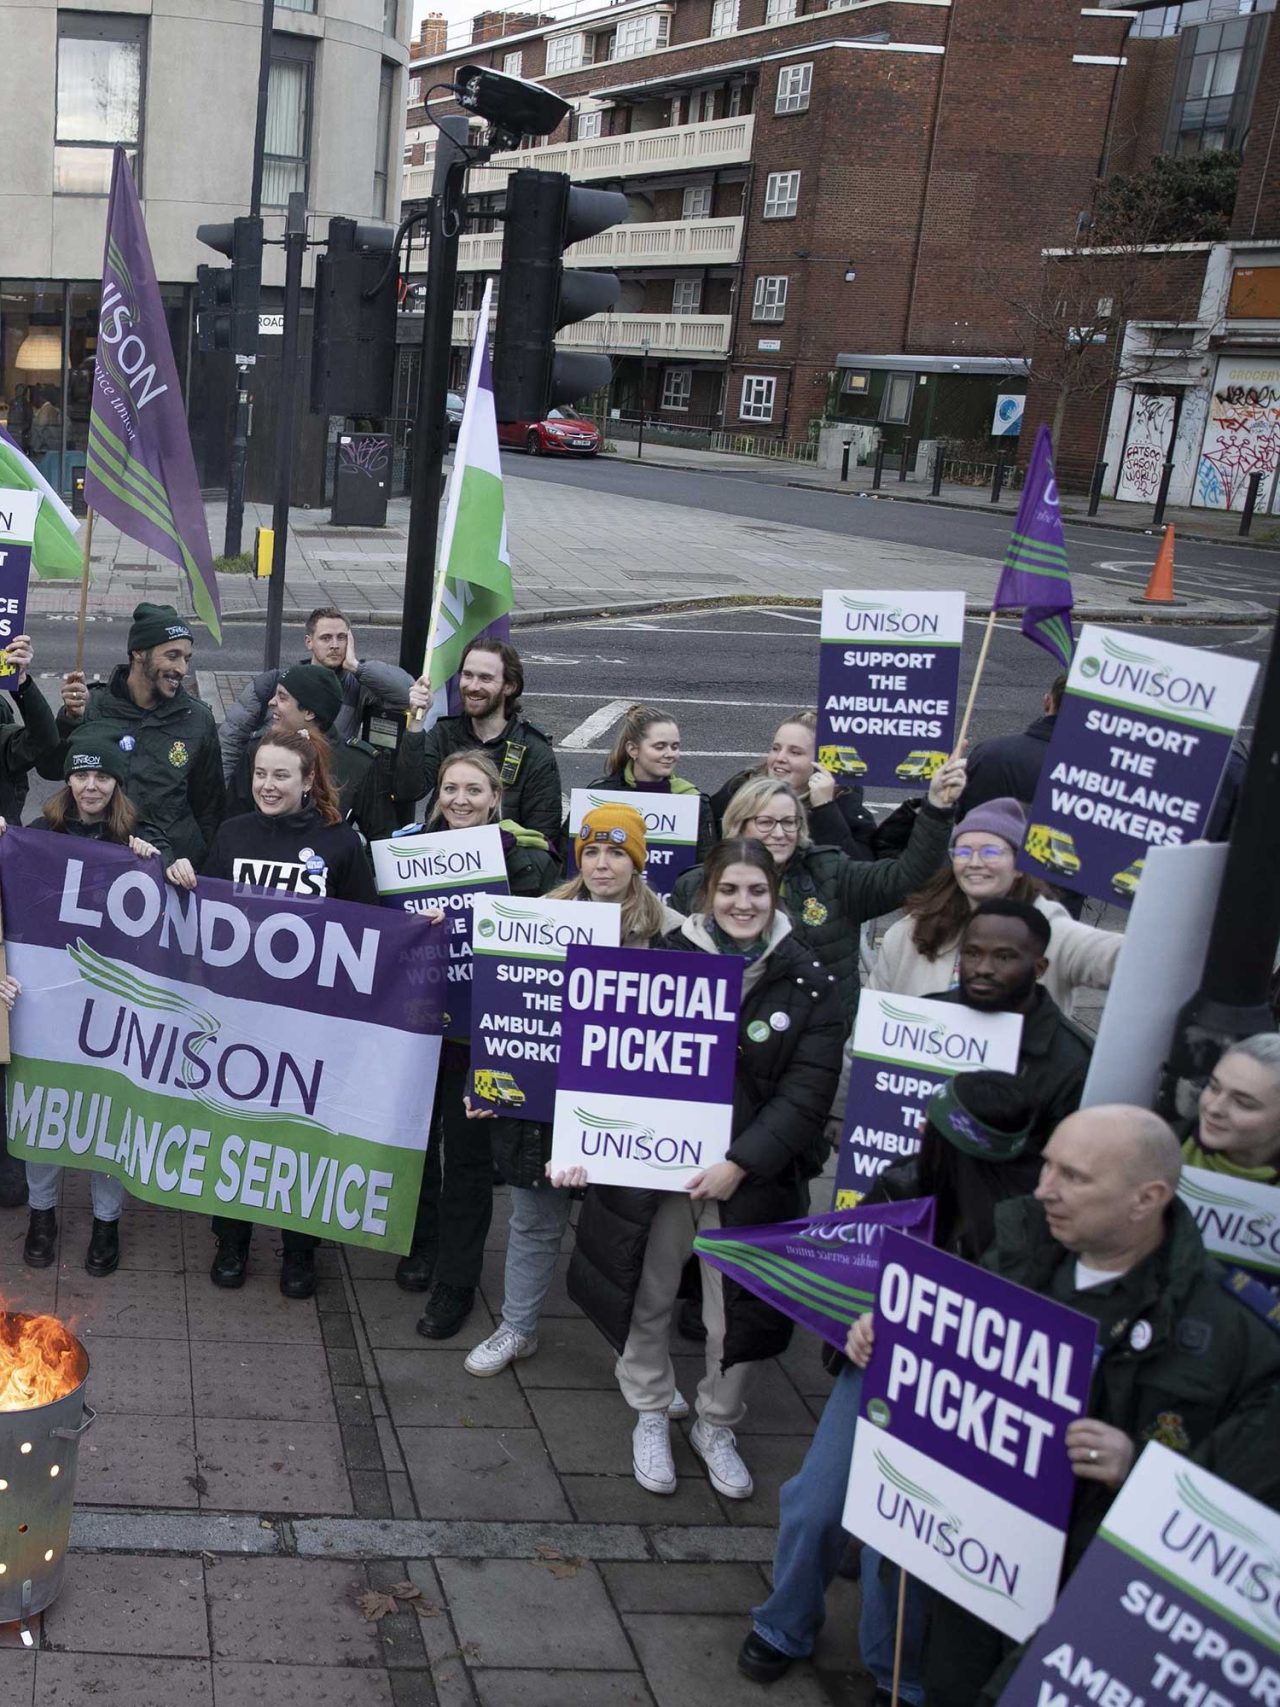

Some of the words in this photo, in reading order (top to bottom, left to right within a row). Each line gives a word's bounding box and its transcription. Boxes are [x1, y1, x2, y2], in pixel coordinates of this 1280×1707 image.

[846, 612, 939, 633] UNISON
[843, 651, 936, 669] SUPPORT
[868, 674, 907, 691] THE
[1100, 659, 1216, 711] UNISON
[825, 695, 949, 715] AMBULANCE
[829, 715, 942, 738] WORKERS
[1084, 709, 1199, 757] SUPPORT
[1109, 746, 1157, 778] THE
[1049, 762, 1201, 823] AMBULANCE
[1050, 787, 1185, 847] WORKERS
[238, 862, 324, 900] NHS
[397, 850, 482, 880] UNISON
[403, 891, 486, 915] SUPPOR
[58, 858, 381, 995] LONDON
[498, 920, 593, 946] UNISON
[407, 963, 473, 986] WORK
[496, 964, 564, 987] SUPPO
[522, 992, 562, 1012] THE
[568, 967, 736, 1022] OFFICIAL
[479, 1013, 561, 1037] AMBULA
[881, 1022, 988, 1063] UNISON
[78, 998, 324, 1116] UNISON
[484, 1036, 560, 1063] WORK
[581, 1024, 718, 1077] PICKET
[874, 1071, 944, 1099] SUPP
[7, 1081, 212, 1196] MBULANCE
[214, 1134, 394, 1237] SERVICE
[580, 1130, 702, 1165] UNISON
[879, 1261, 1082, 1415] OFFICIAL
[886, 1343, 1055, 1479] PICKET
[876, 1483, 1019, 1596] UNISON
[1160, 1509, 1280, 1618] UNIS
[1120, 1580, 1280, 1707] SUPPOR
